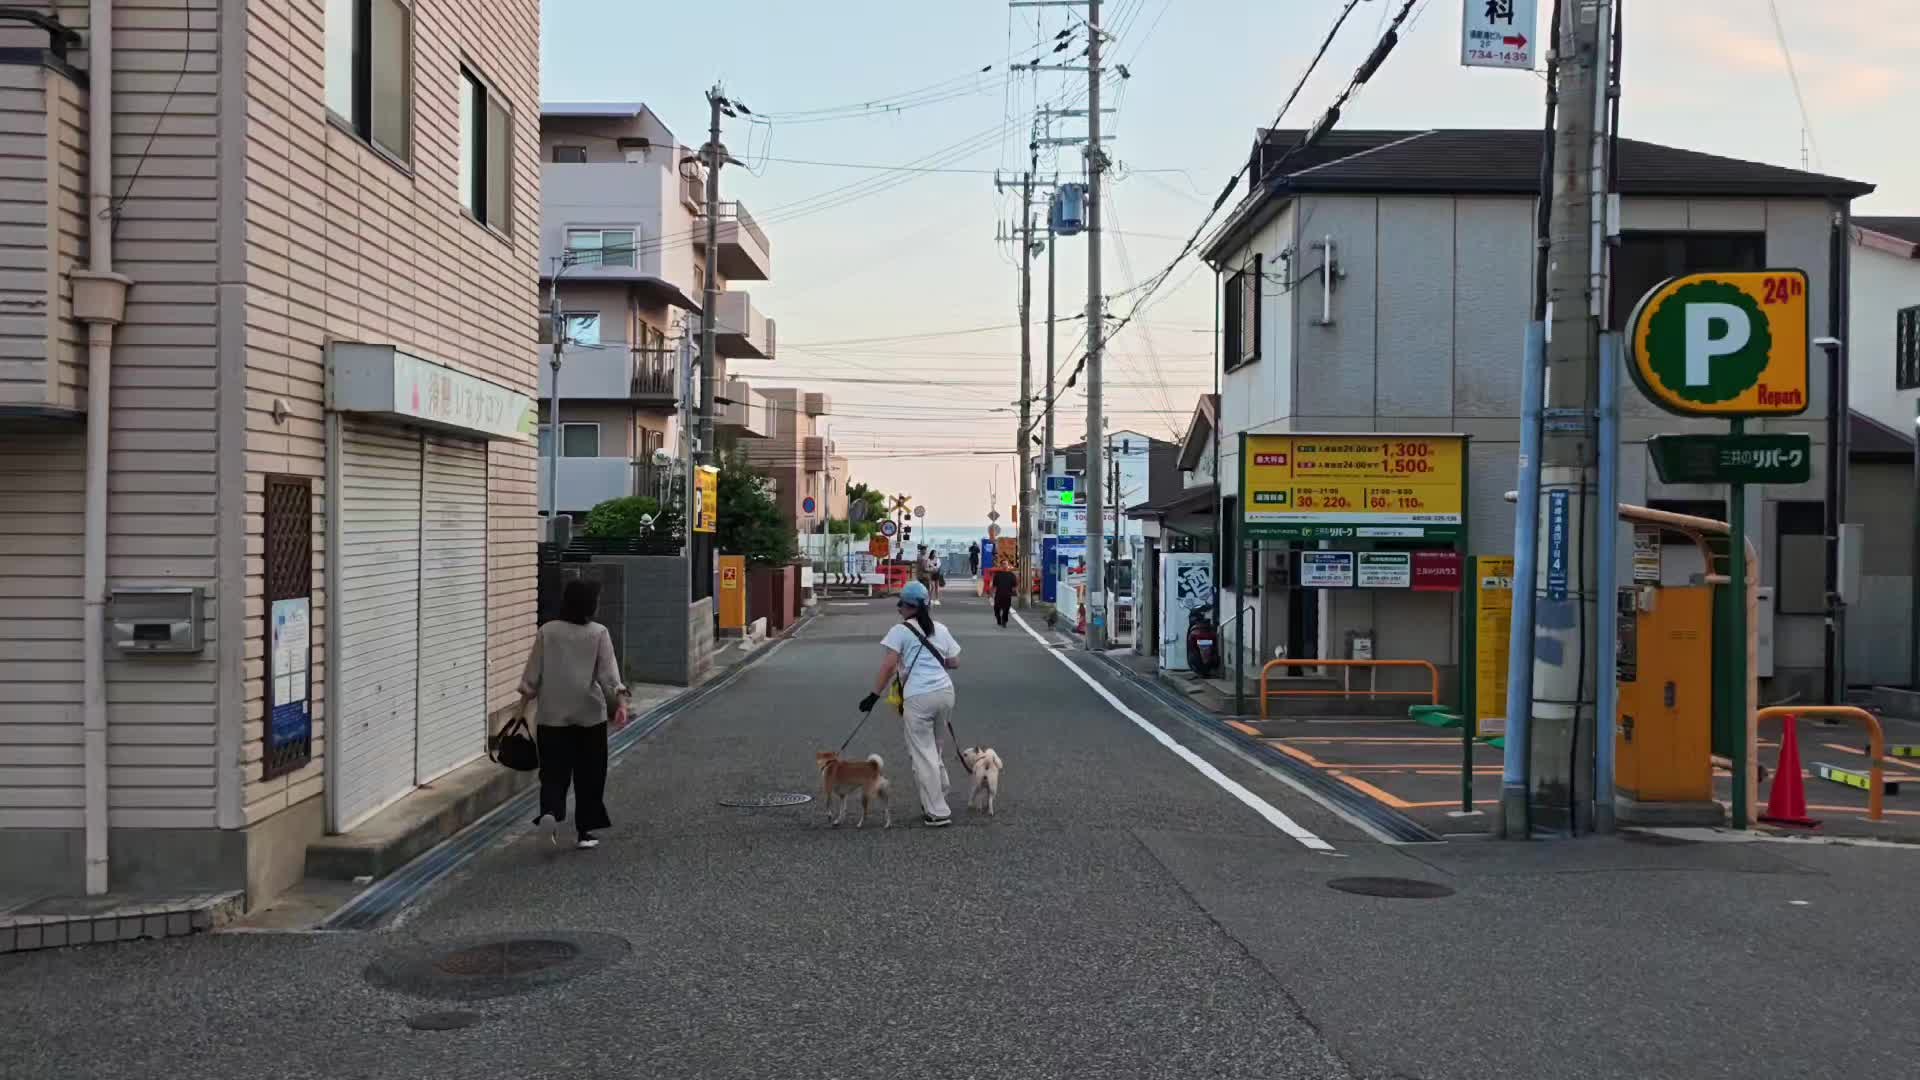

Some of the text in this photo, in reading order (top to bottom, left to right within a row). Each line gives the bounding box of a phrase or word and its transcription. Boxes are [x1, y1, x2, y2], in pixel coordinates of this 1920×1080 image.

[1469, 49, 1527, 62] 734-1439
[1763, 277, 1802, 305] 24h
[1685, 303, 1751, 386] P
[1758, 384, 1802, 407] Repark
[1719, 447, 1803, 468] 三井のリパーク
